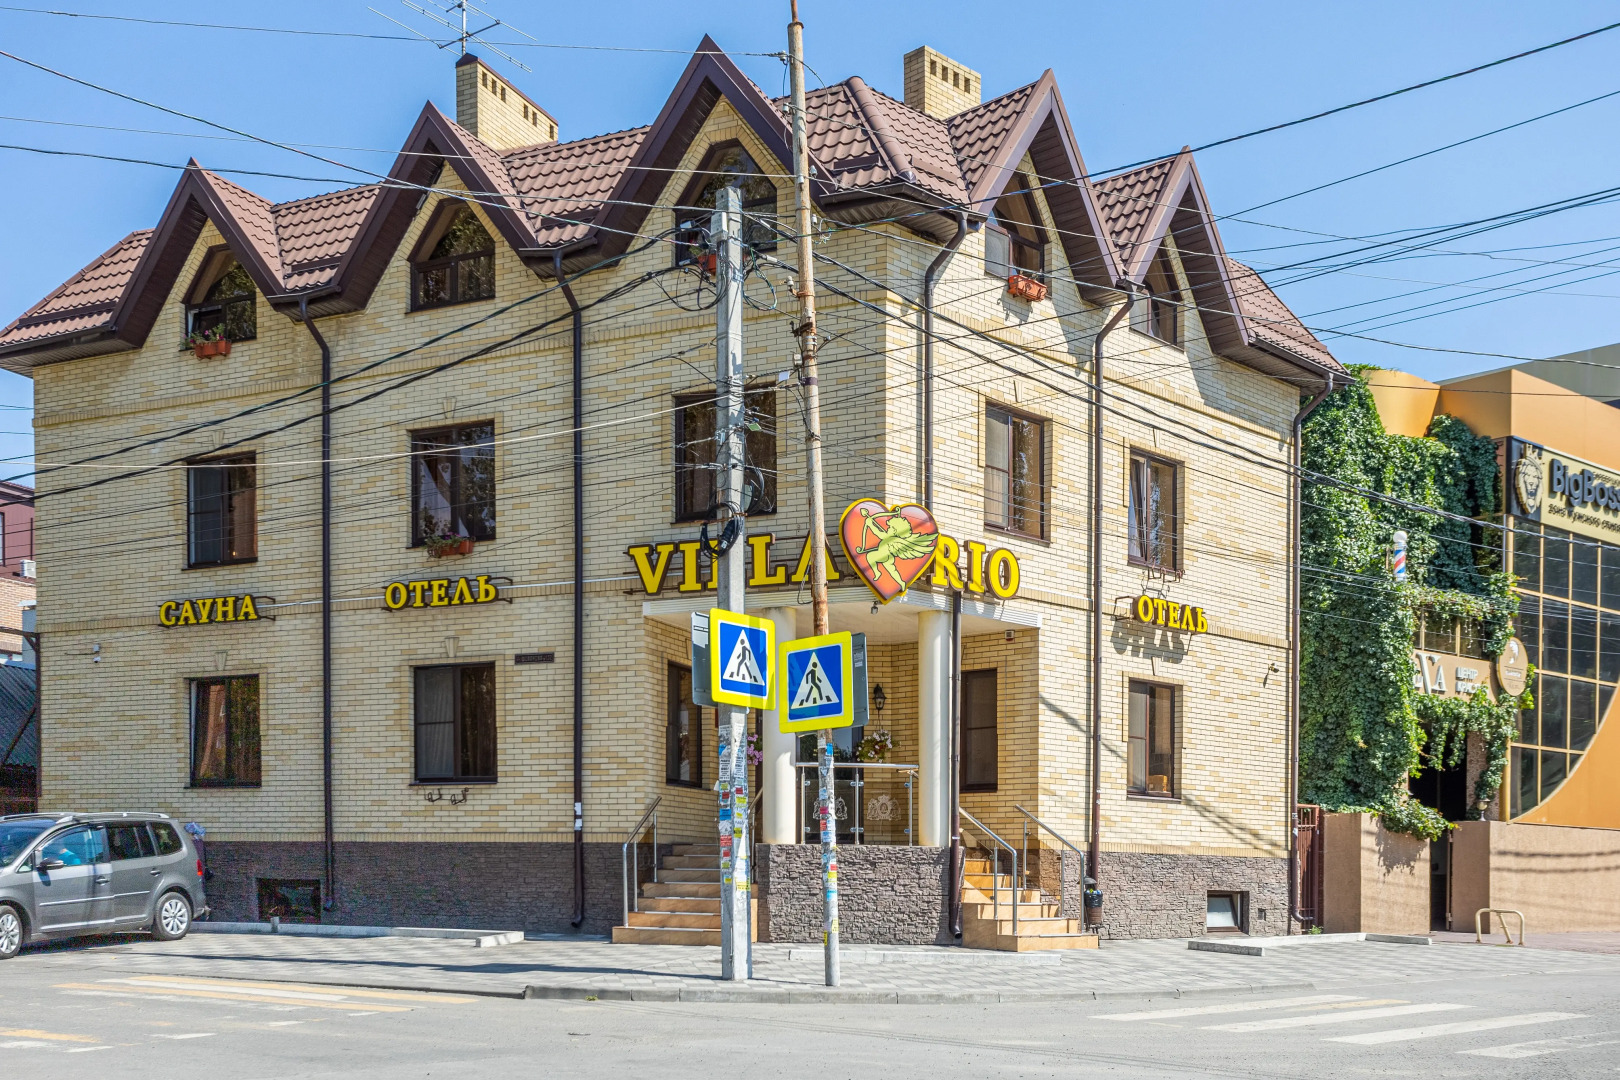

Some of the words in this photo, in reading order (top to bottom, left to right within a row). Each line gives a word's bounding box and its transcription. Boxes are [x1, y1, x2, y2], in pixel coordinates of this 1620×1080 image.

[929, 535, 1021, 599] RIO
[159, 595, 259, 626] САУНА
[384, 575, 498, 610] ОТЕЛЬ
[1134, 595, 1209, 633] ОТЕЛЬ
